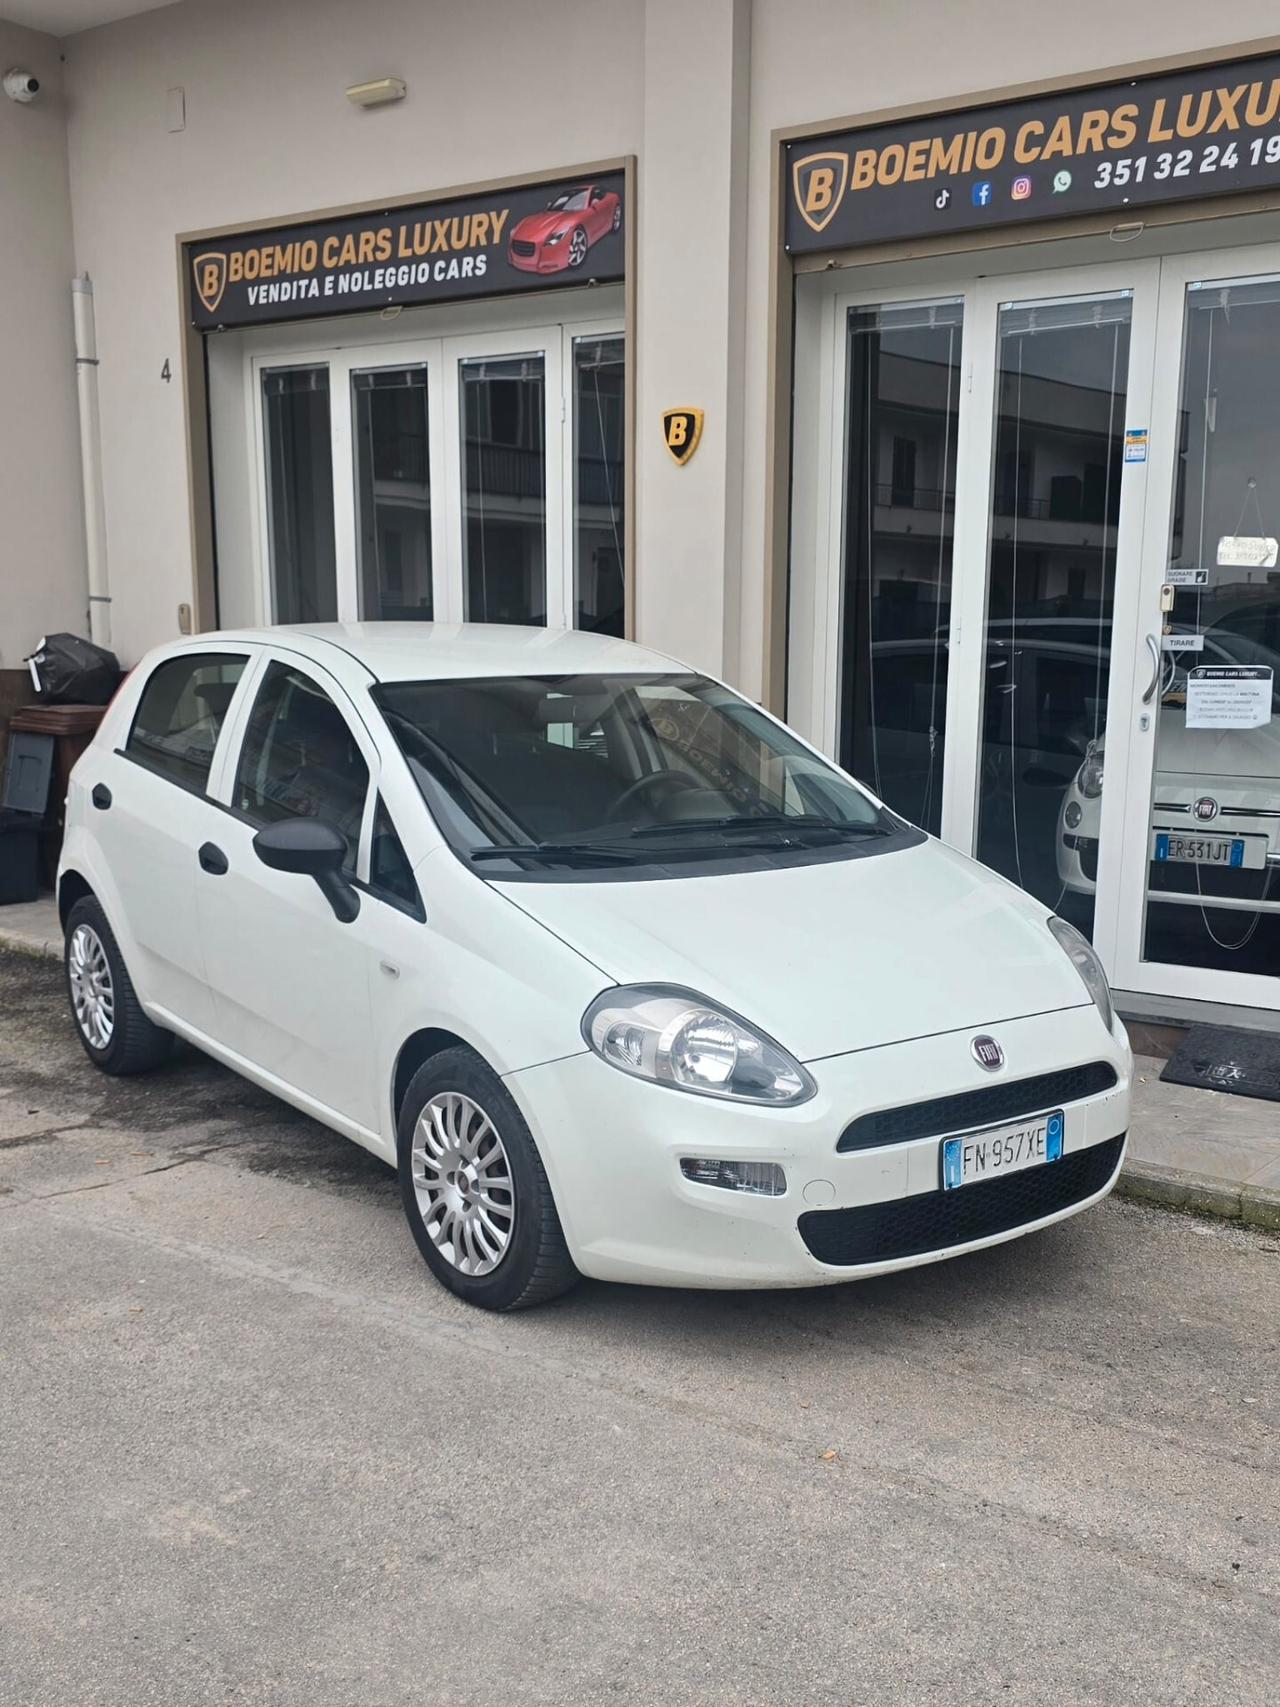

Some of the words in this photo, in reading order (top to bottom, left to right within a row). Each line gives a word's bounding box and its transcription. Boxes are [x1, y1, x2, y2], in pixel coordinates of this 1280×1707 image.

[851, 127, 1006, 191] BOEMIO
[1013, 104, 1139, 164] CARS
[1147, 78, 1280, 143] LUXU
[1094, 156, 1147, 189] 351
[1153, 149, 1193, 180] 32
[1199, 142, 1239, 173] 24
[806, 168, 834, 212] B
[229, 239, 318, 283] BOEMIO
[322, 227, 393, 266] CARS
[398, 209, 510, 258] LUXURY
[203, 264, 219, 297] B
[247, 277, 320, 306] VENDITA
[324, 275, 335, 290] E
[338, 261, 430, 289] NOLEGGIO
[433, 254, 488, 282] CARS
[161, 357, 172, 384] 4
[669, 416, 687, 446] B
[1198, 804, 1213, 816] FIAT
[978, 1043, 999, 1062] FIAT
